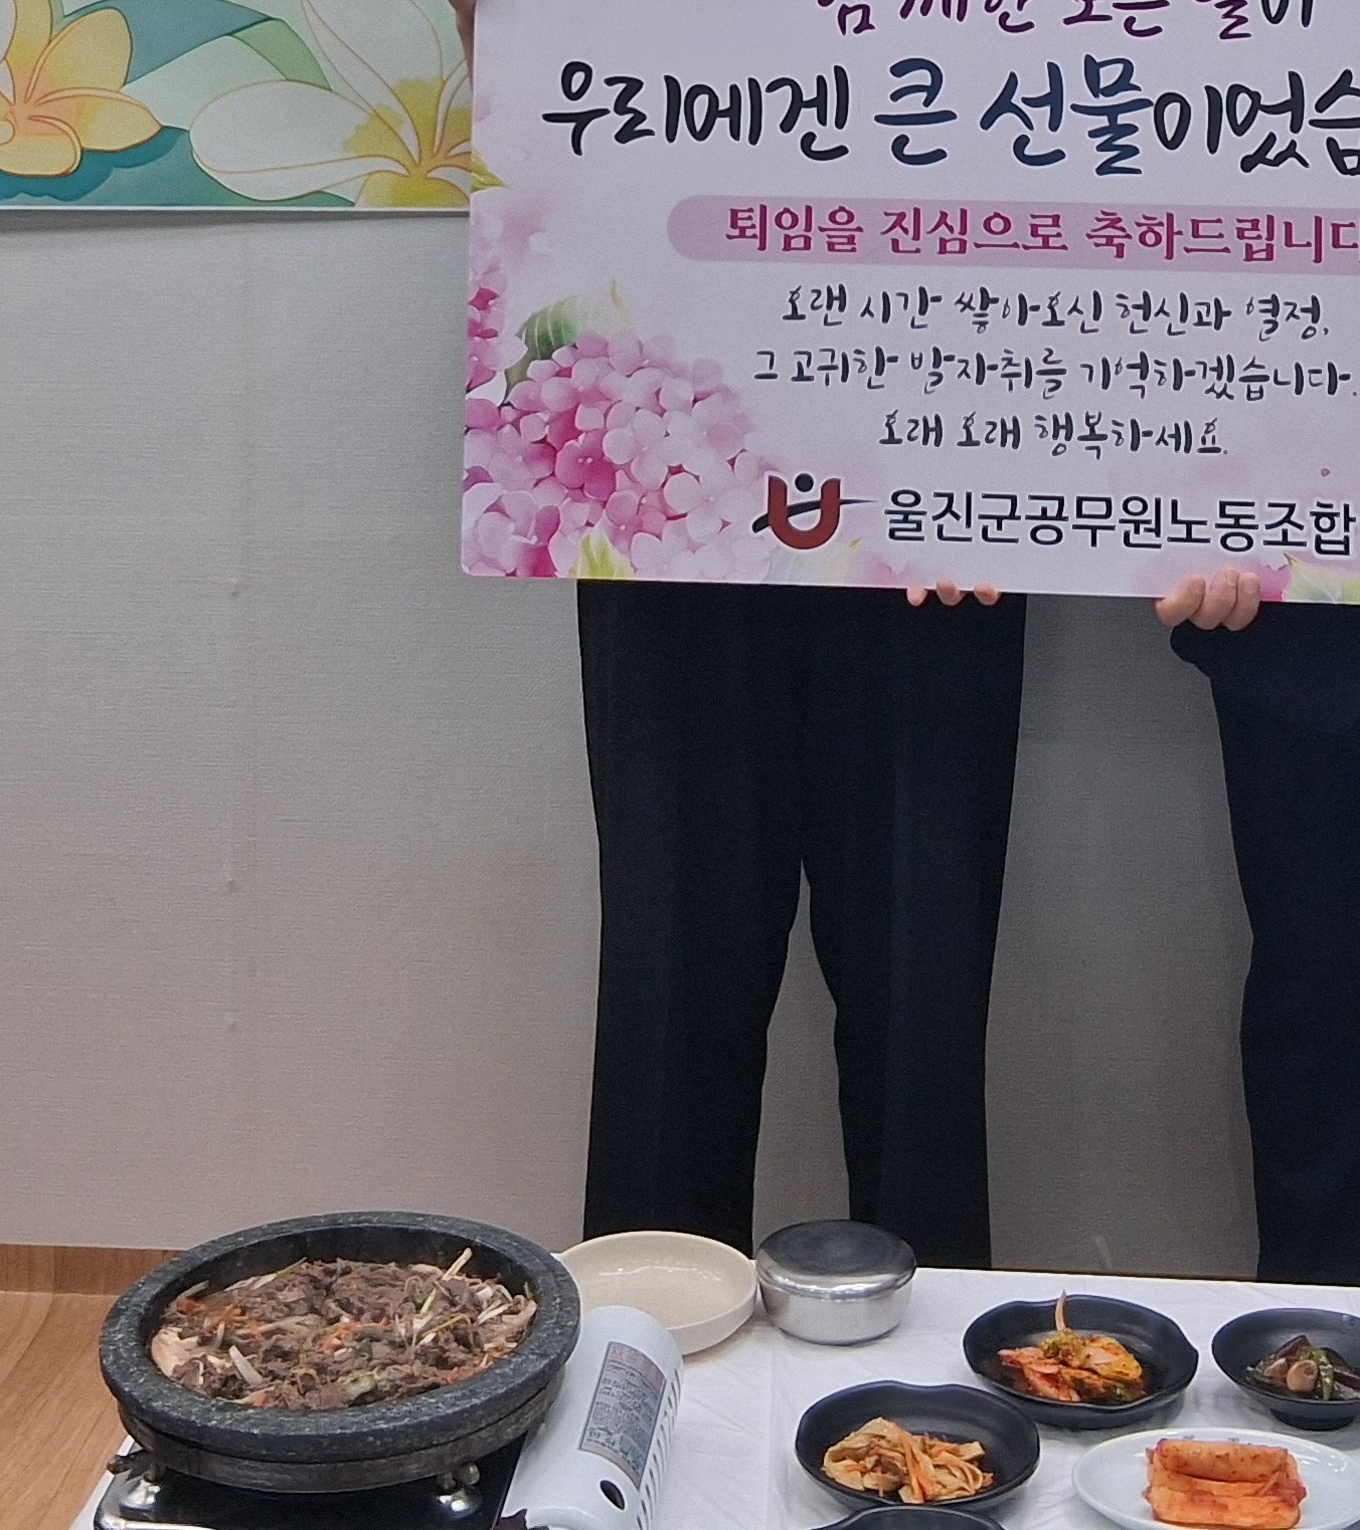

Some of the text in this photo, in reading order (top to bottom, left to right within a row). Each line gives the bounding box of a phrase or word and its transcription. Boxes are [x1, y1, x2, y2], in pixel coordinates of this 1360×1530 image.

[542, 61, 849, 161] 우리에겐
[874, 58, 957, 164] 큰
[726, 204, 863, 252] 퇴임을
[881, 207, 1068, 254] 진심으로
[783, 284, 1328, 341] 오랜 시간 쌓아오신 헌신과 열정,
[754, 346, 1357, 401] 그 고귀한 발자취를 기억하겠습니다.
[879, 410, 1227, 460] 오래 오래 행복하세요.
[884, 490, 1356, 557] 울진군공무원노동조합
